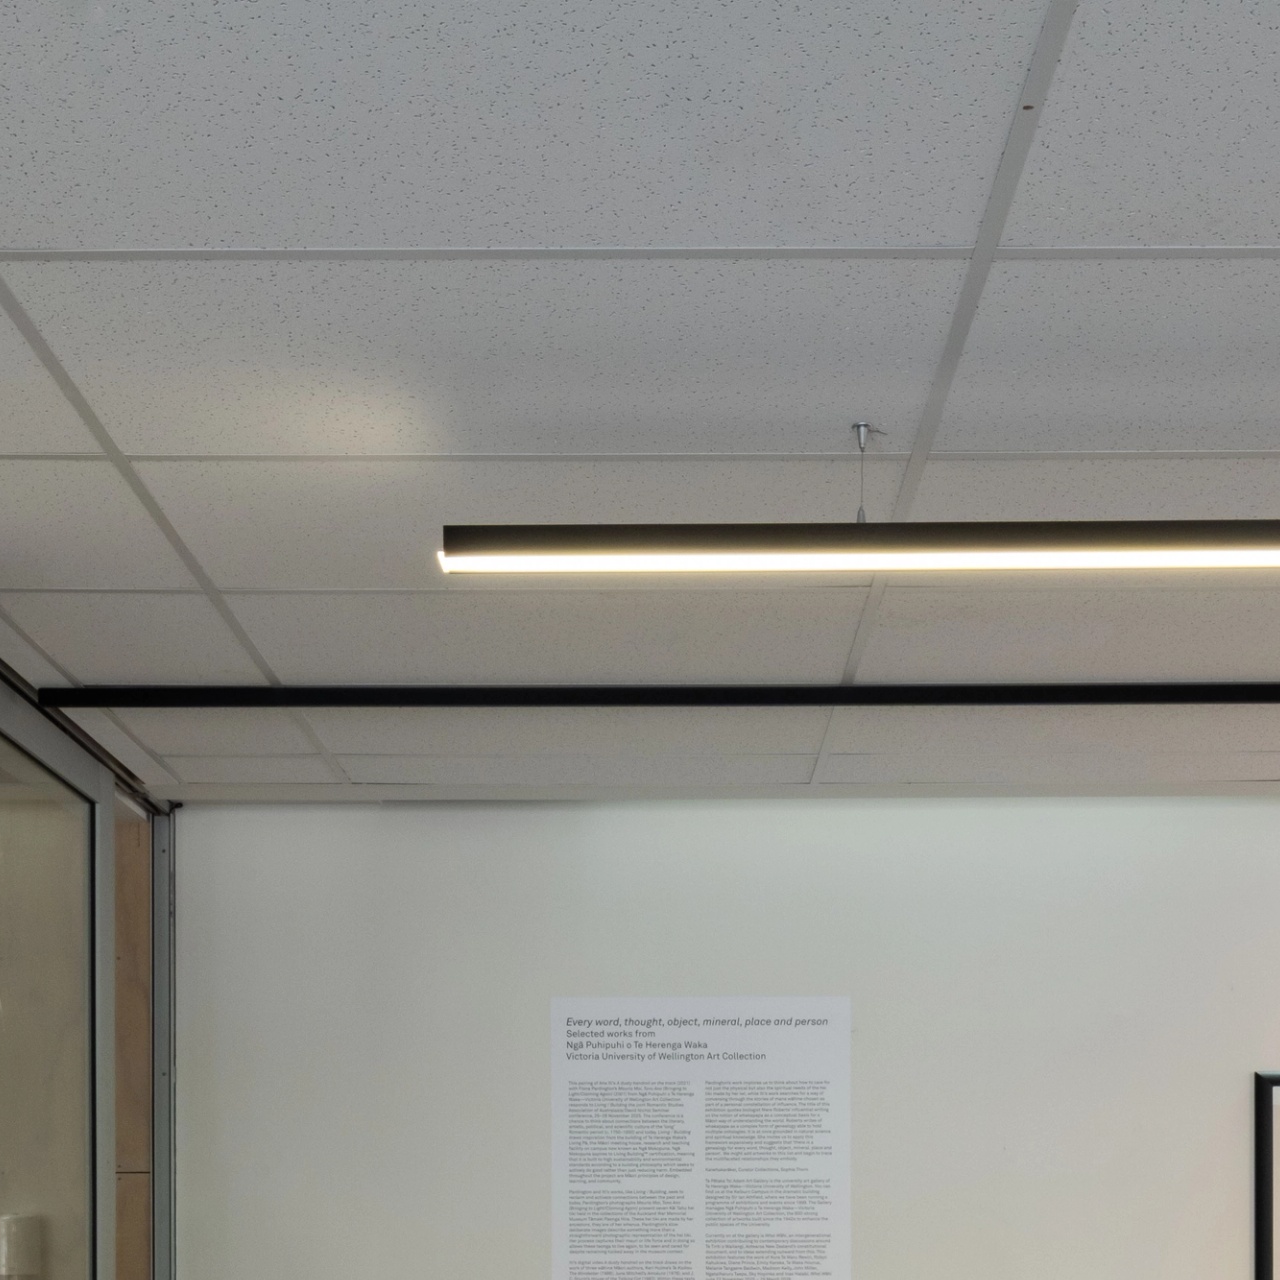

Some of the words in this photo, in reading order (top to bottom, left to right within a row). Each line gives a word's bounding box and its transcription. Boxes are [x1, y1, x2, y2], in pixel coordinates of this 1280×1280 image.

[566, 1017, 593, 1028] Every
[595, 1017, 622, 1028] word,
[624, 1017, 665, 1028] thought,
[667, 1017, 700, 1028] object,
[703, 1017, 743, 1028] mineral,
[744, 1017, 772, 1028] place
[774, 1017, 793, 1026] and
[794, 1018, 828, 1028] person
[566, 1029, 605, 1038] Selected
[607, 1029, 633, 1038] works
[635, 1029, 656, 1038] from
[566, 1041, 584, 1051] Ngā
[586, 1041, 625, 1051] Puhipuhi
[634, 1041, 643, 1049] Te
[645, 1041, 682, 1051] Herenga
[684, 1041, 708, 1049] Waka
[566, 1052, 600, 1061] Victoria
[601, 1052, 645, 1062] University
[647, 1052, 656, 1061] of
[658, 1052, 705, 1062] Wellington
[707, 1052, 720, 1061] Art
[722, 1052, 767, 1061] Collection
